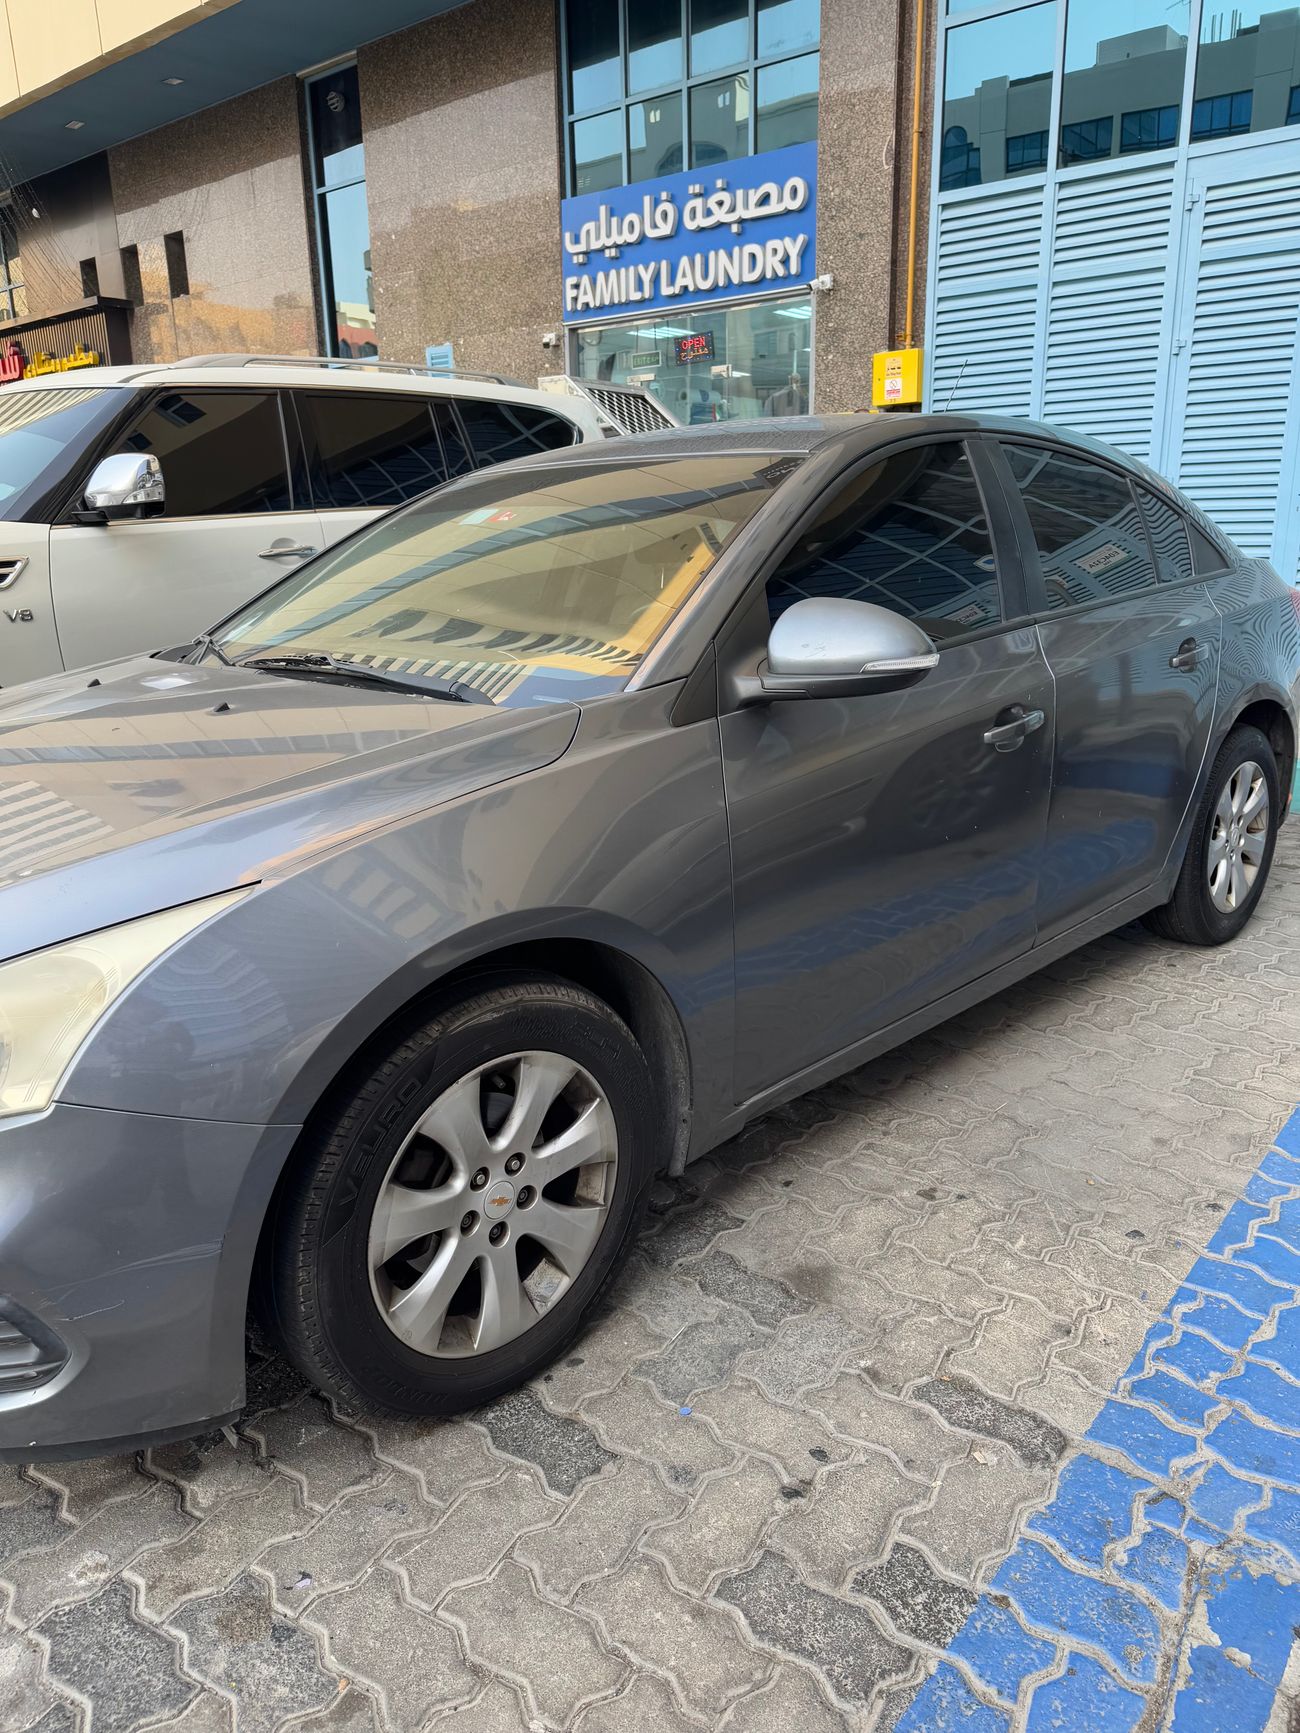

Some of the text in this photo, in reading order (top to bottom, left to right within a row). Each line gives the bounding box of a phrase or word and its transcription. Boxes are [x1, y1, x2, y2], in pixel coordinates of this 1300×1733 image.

[565, 176, 807, 264] مصبغة فاميلي
[565, 234, 808, 312] FAMILY LAUNDRY
[681, 336, 706, 351] OPEN
[3, 608, 33, 623] V8
